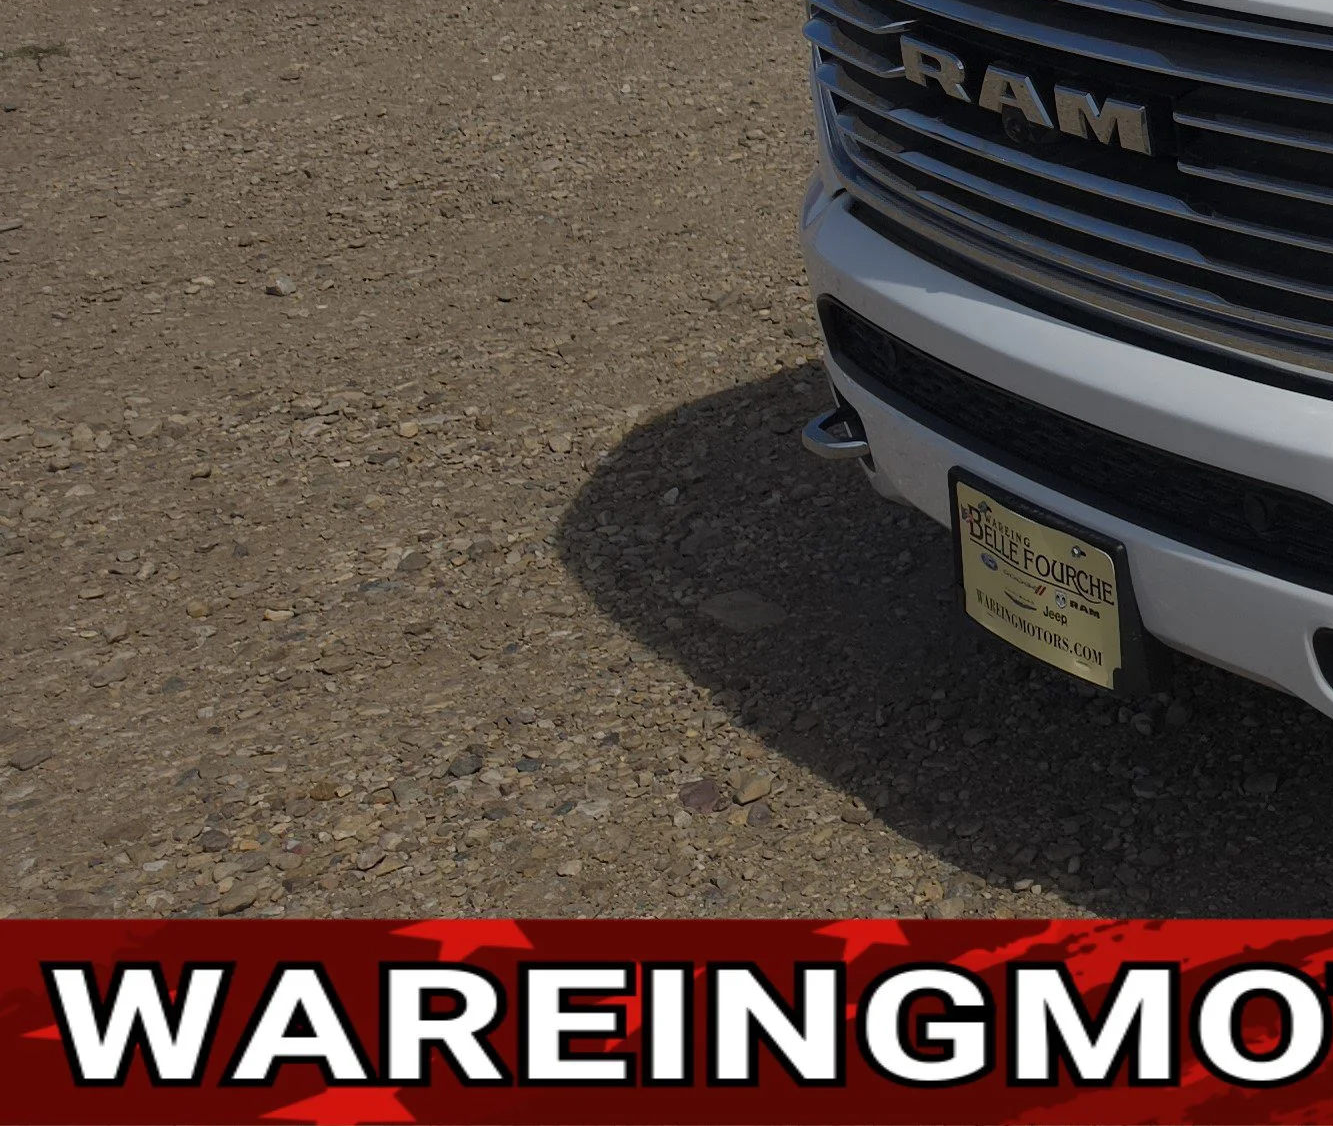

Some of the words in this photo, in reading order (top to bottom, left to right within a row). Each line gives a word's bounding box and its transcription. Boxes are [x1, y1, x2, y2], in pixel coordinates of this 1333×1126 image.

[900, 34, 1153, 156] RAM
[967, 502, 1020, 566] BELLE
[1022, 547, 1115, 607] FOURCHE
[975, 587, 1103, 667] WAREINGMOTORS.COM
[1042, 605, 1068, 627] Jeep
[1069, 599, 1101, 620] RAM
